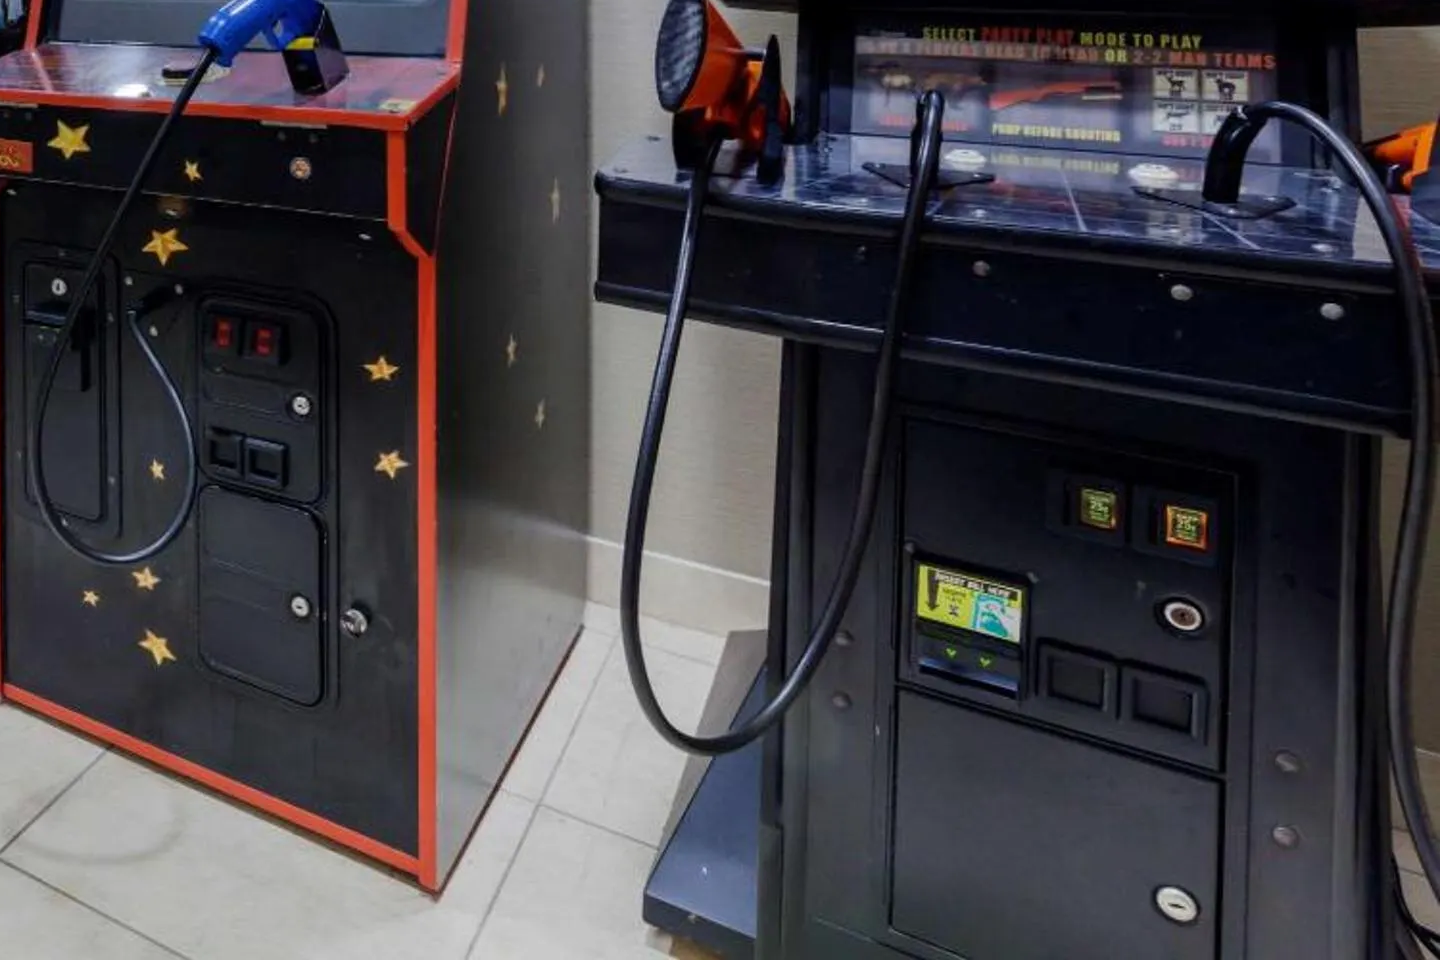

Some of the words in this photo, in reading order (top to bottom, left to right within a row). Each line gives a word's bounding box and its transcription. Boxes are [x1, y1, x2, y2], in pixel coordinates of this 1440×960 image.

[922, 26, 977, 42] SELECT
[1080, 31, 1127, 47] MODE
[1132, 33, 1154, 48] TO
[1160, 34, 1204, 51] PLAY
[1103, 48, 1128, 64] OR
[1168, 50, 1207, 67] MAN
[1213, 51, 1277, 71] TEAMS
